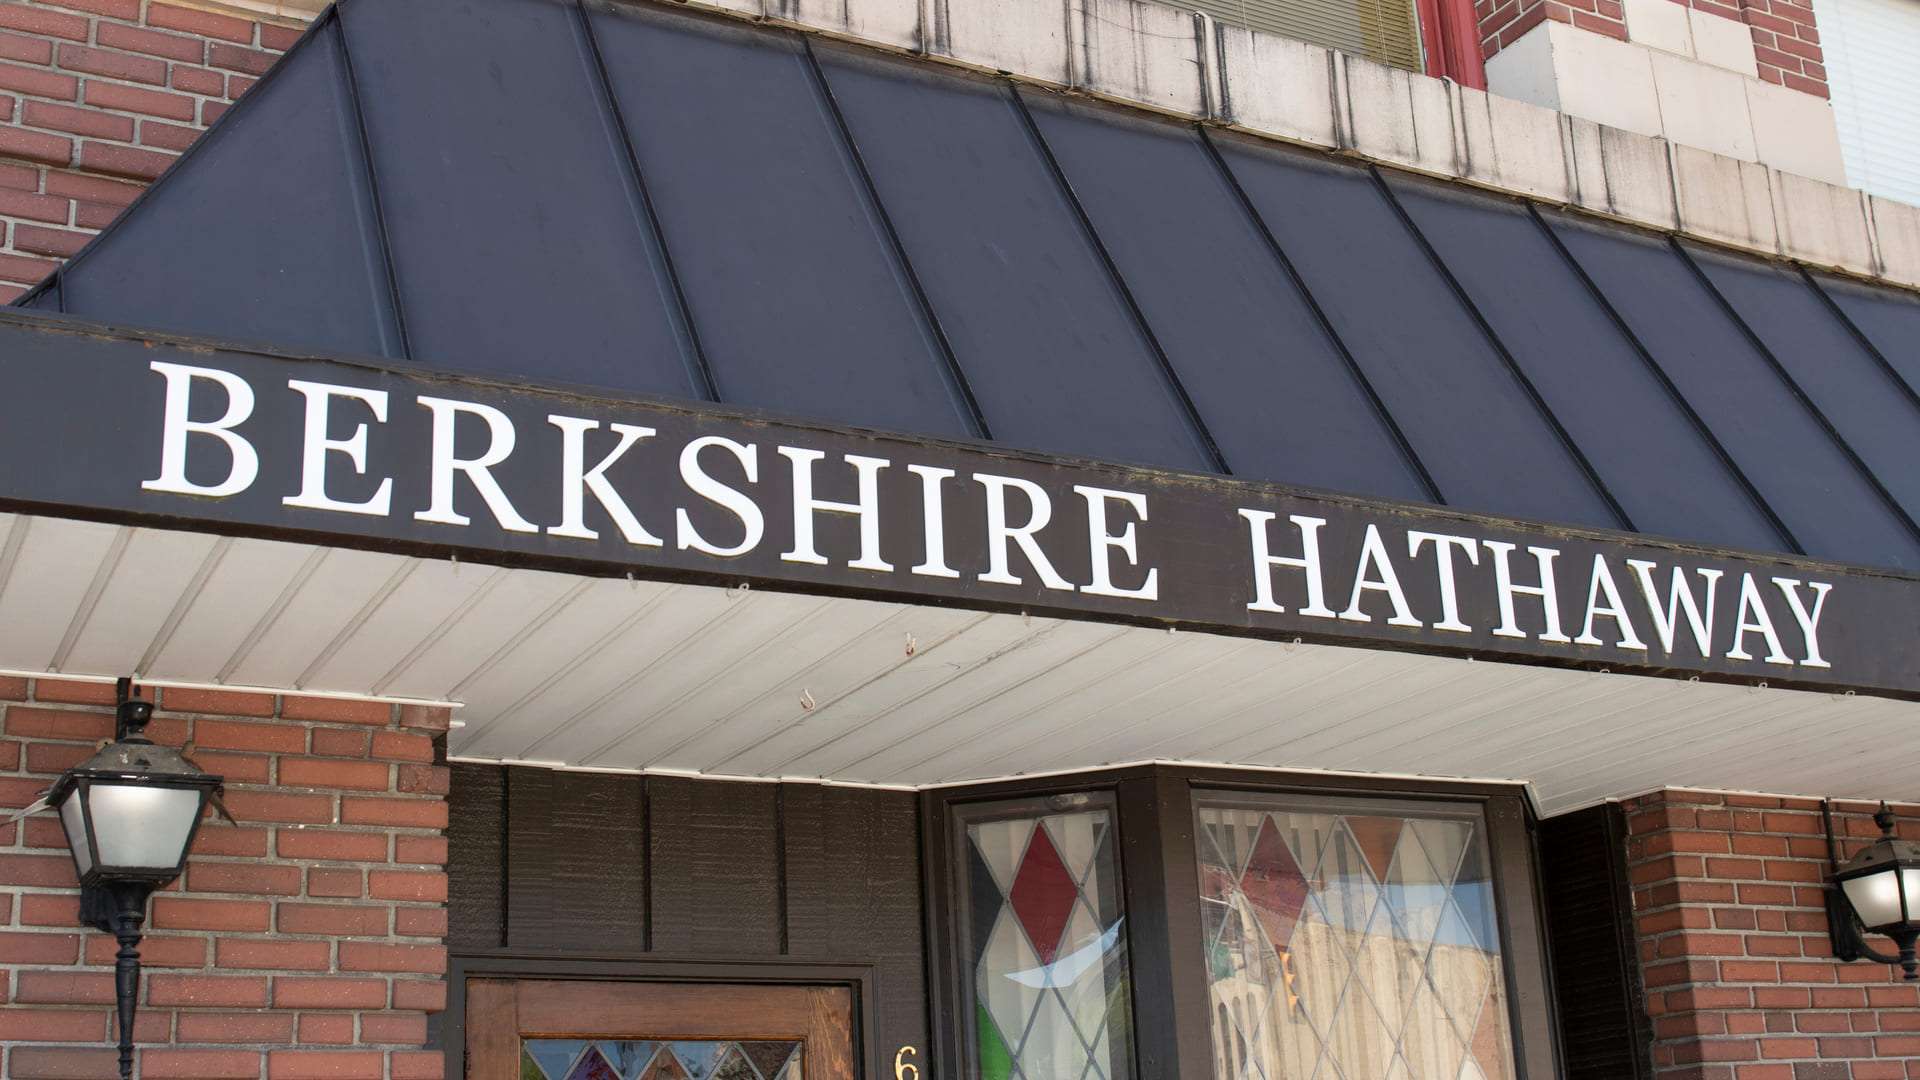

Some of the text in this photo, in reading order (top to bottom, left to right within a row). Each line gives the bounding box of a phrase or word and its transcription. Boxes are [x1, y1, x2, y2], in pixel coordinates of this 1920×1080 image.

[141, 360, 1834, 669] BERKSHIRE HATHAWAY
[895, 1045, 919, 1080] 6
